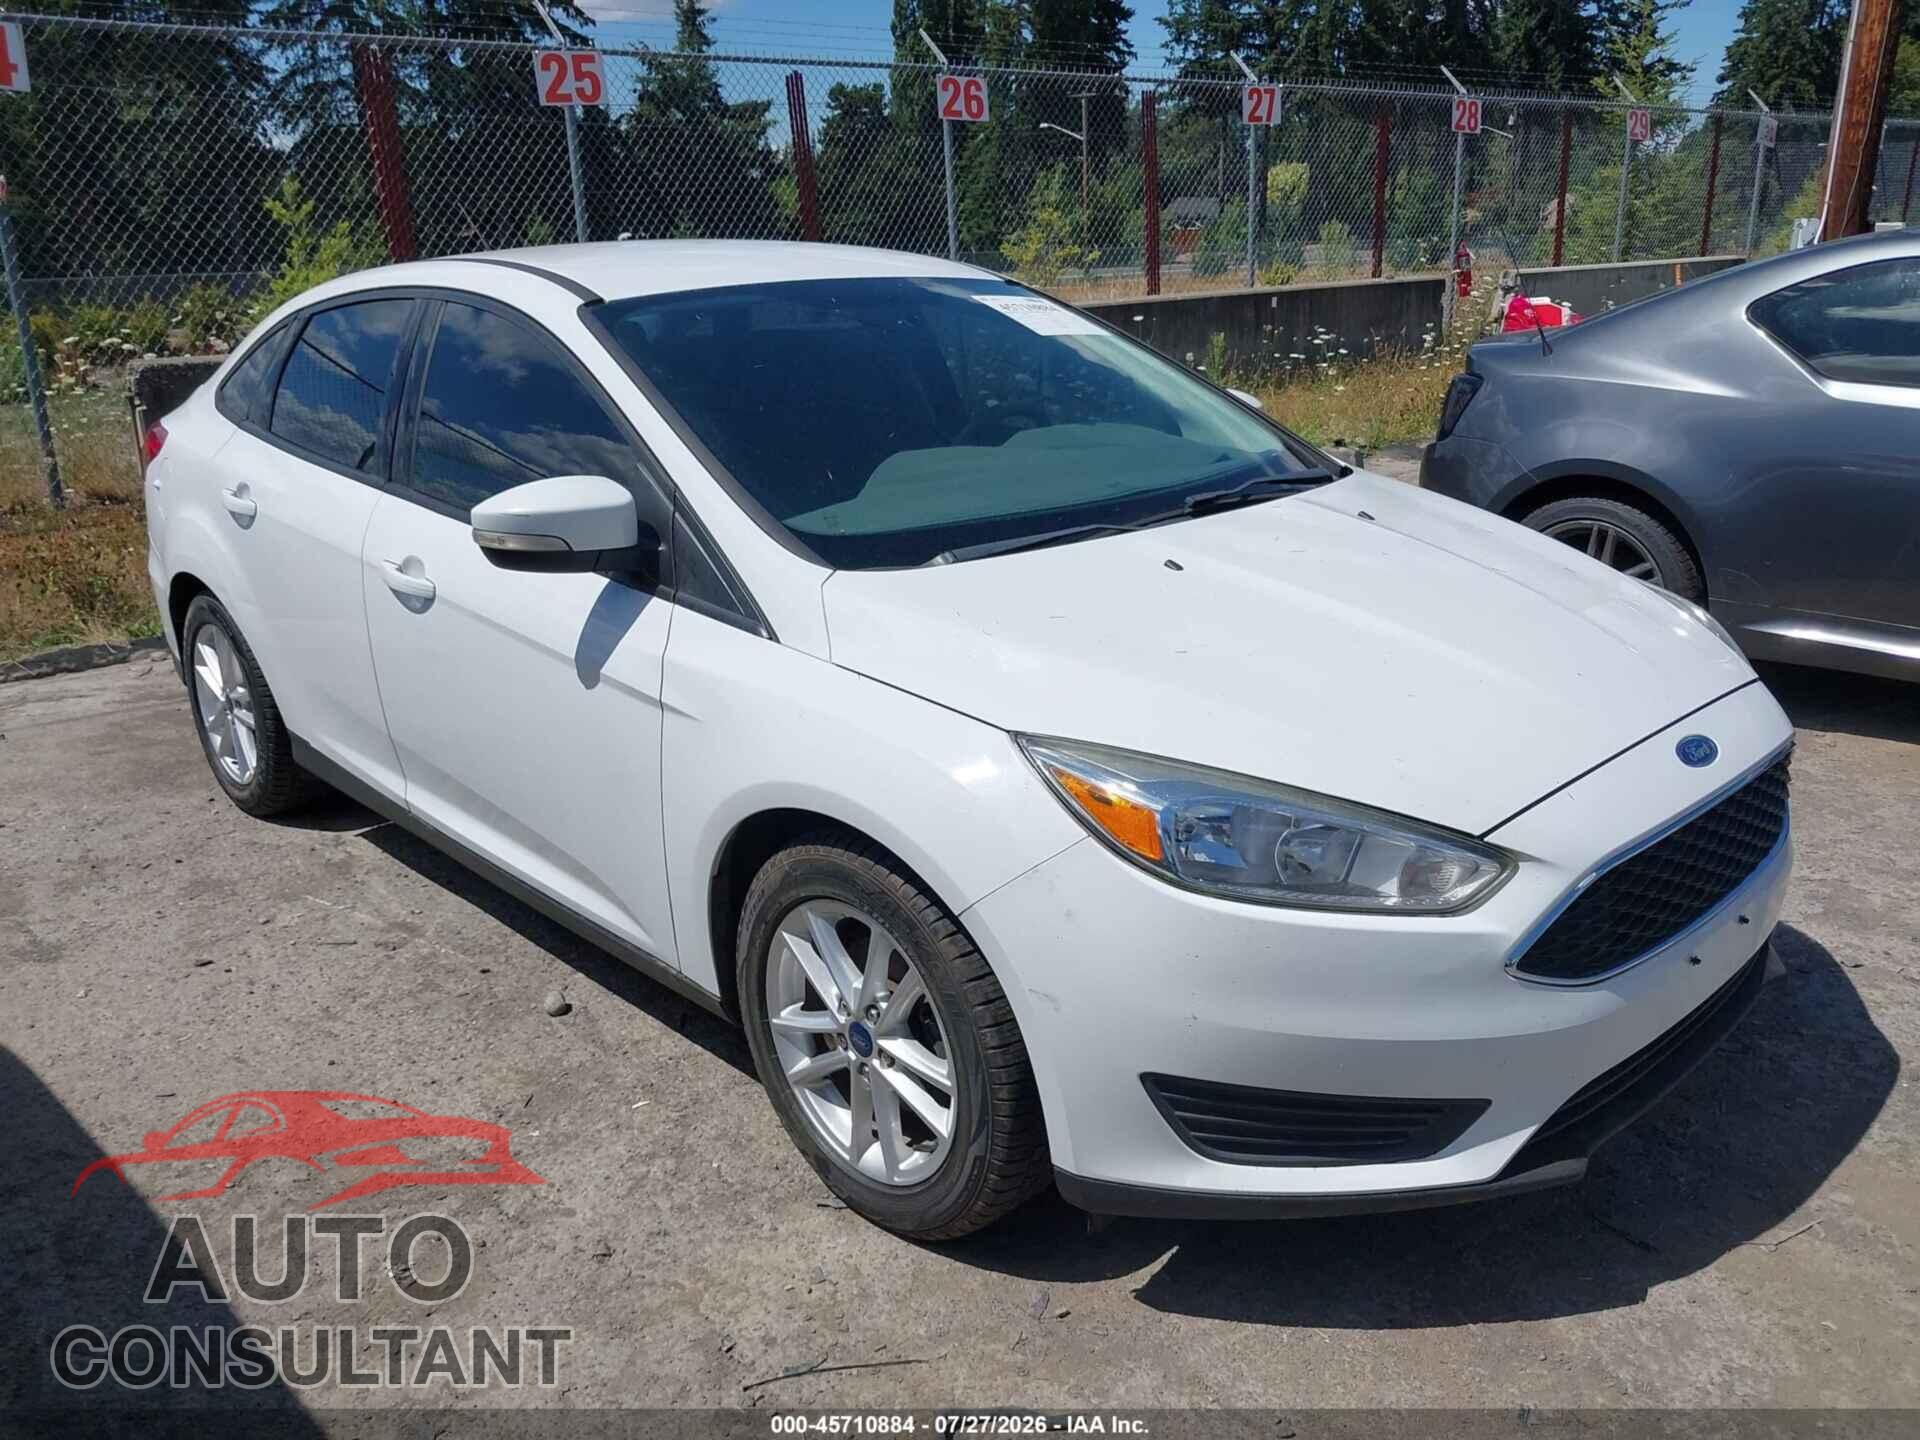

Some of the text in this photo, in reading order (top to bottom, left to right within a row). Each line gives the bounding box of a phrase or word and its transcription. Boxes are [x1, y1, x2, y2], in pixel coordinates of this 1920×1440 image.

[540, 53, 601, 104] 25
[942, 77, 985, 120] 26
[1247, 87, 1276, 123] 27
[1455, 100, 1478, 131] 28
[1628, 111, 1650, 140] 29
